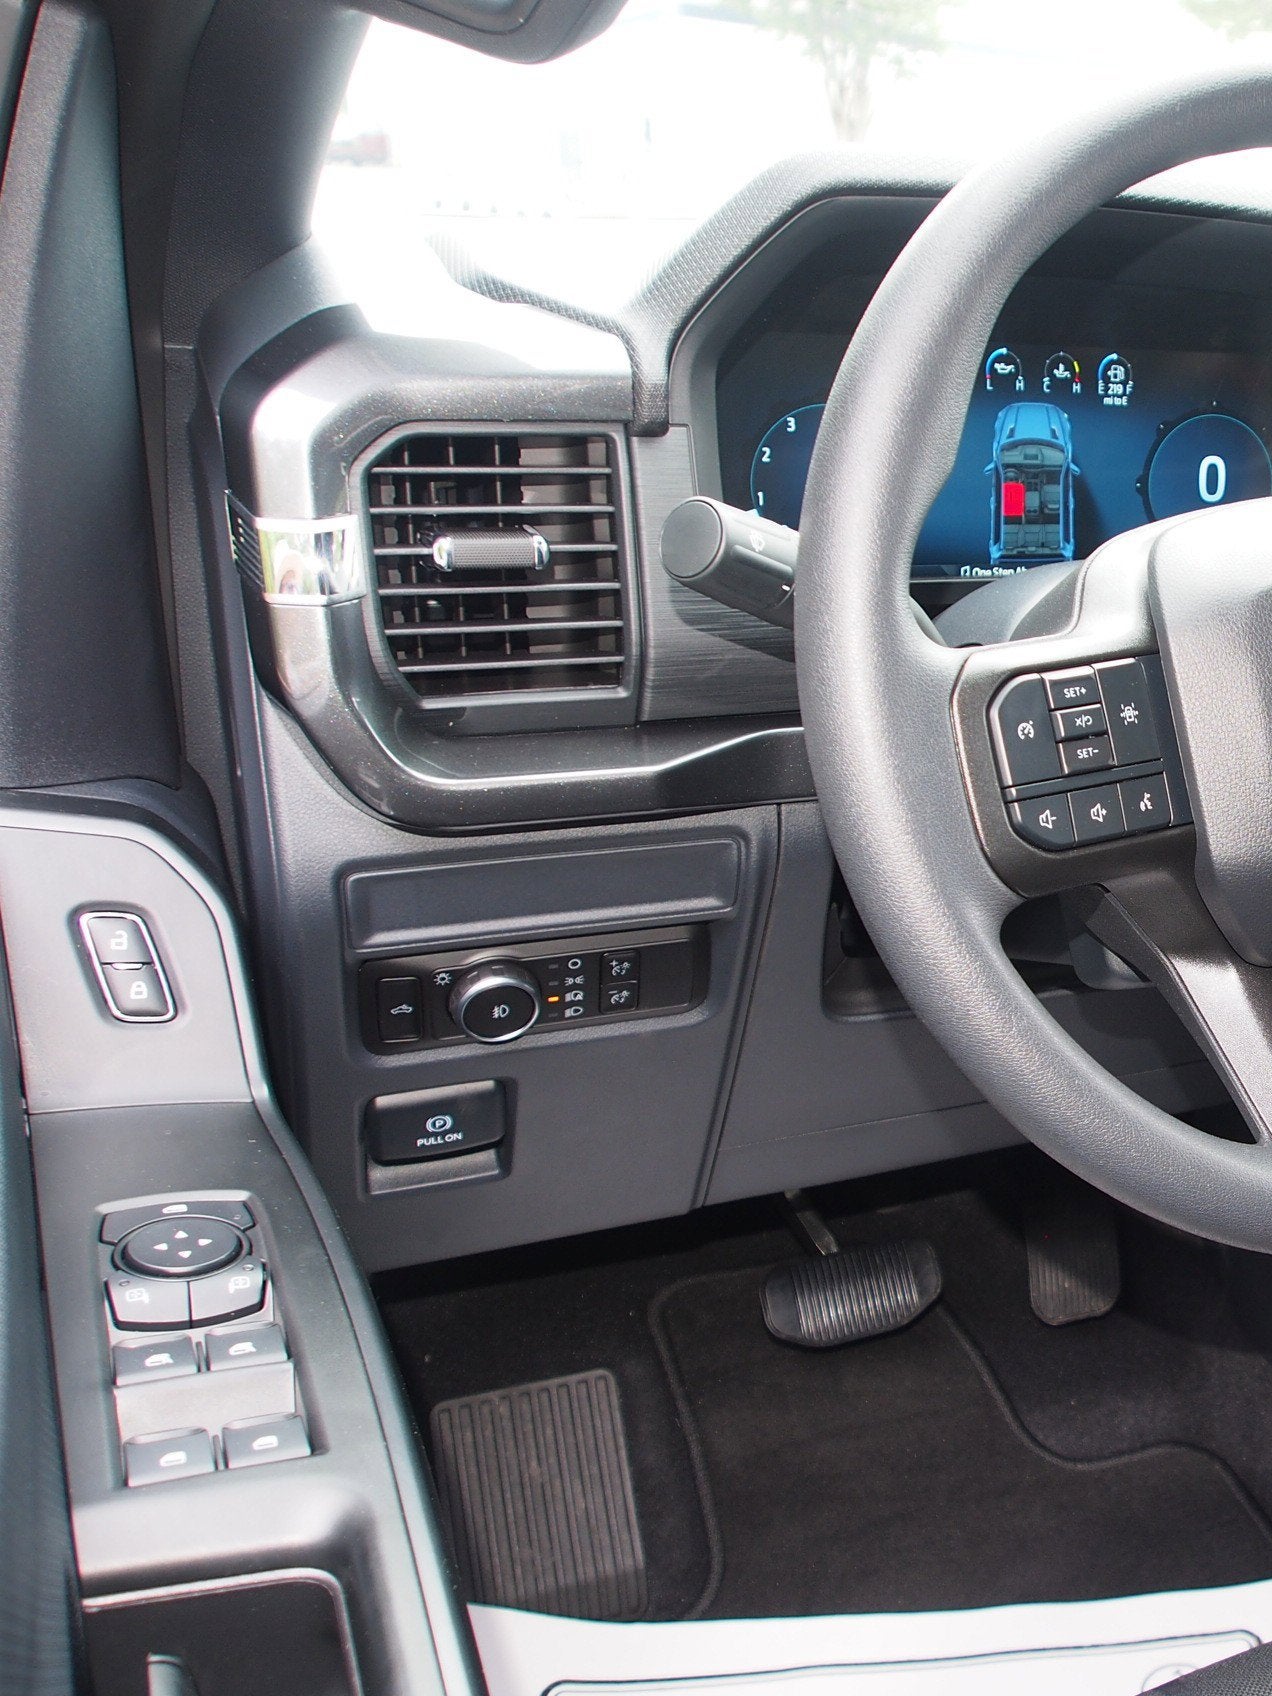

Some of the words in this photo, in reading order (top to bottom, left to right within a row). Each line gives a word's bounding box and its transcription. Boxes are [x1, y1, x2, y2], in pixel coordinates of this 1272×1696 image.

[986, 379, 993, 390] L
[1016, 379, 1025, 391] H
[1073, 382, 1081, 394] H
[1098, 382, 1105, 394] E
[1107, 383, 1124, 395] 219
[786, 417, 796, 432] 3
[762, 447, 771, 462] 2
[1199, 455, 1226, 502] 0
[758, 491, 764, 506] 1
[1063, 686, 1088, 699] SET+
[416, 1136, 444, 1147] PULL
[444, 1132, 462, 1142] ON
